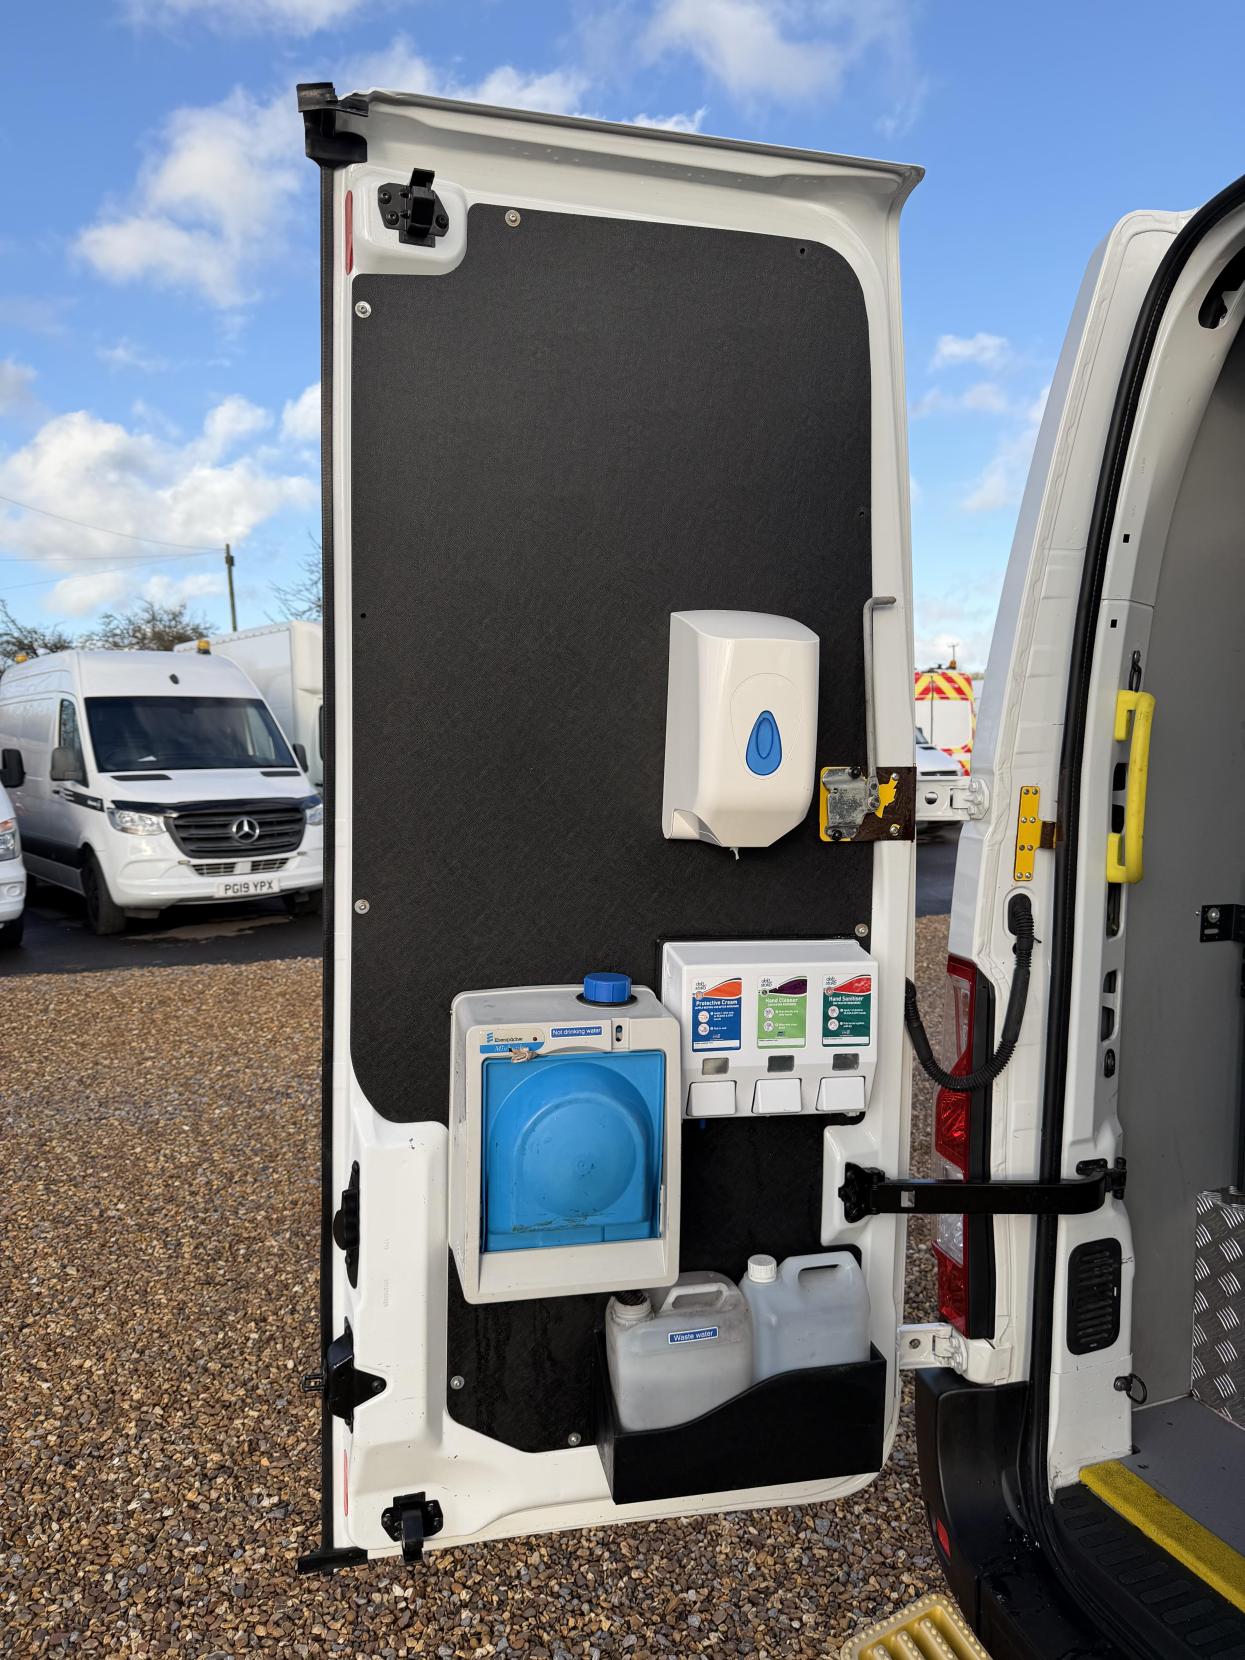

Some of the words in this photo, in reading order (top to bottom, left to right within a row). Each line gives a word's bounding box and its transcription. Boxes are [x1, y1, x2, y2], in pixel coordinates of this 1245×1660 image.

[224, 882, 250, 894] PG19
[253, 880, 274, 891] YPX
[563, 1028, 586, 1036] drinking
[673, 1333, 694, 1341] Waste
[695, 1330, 714, 1339] water
